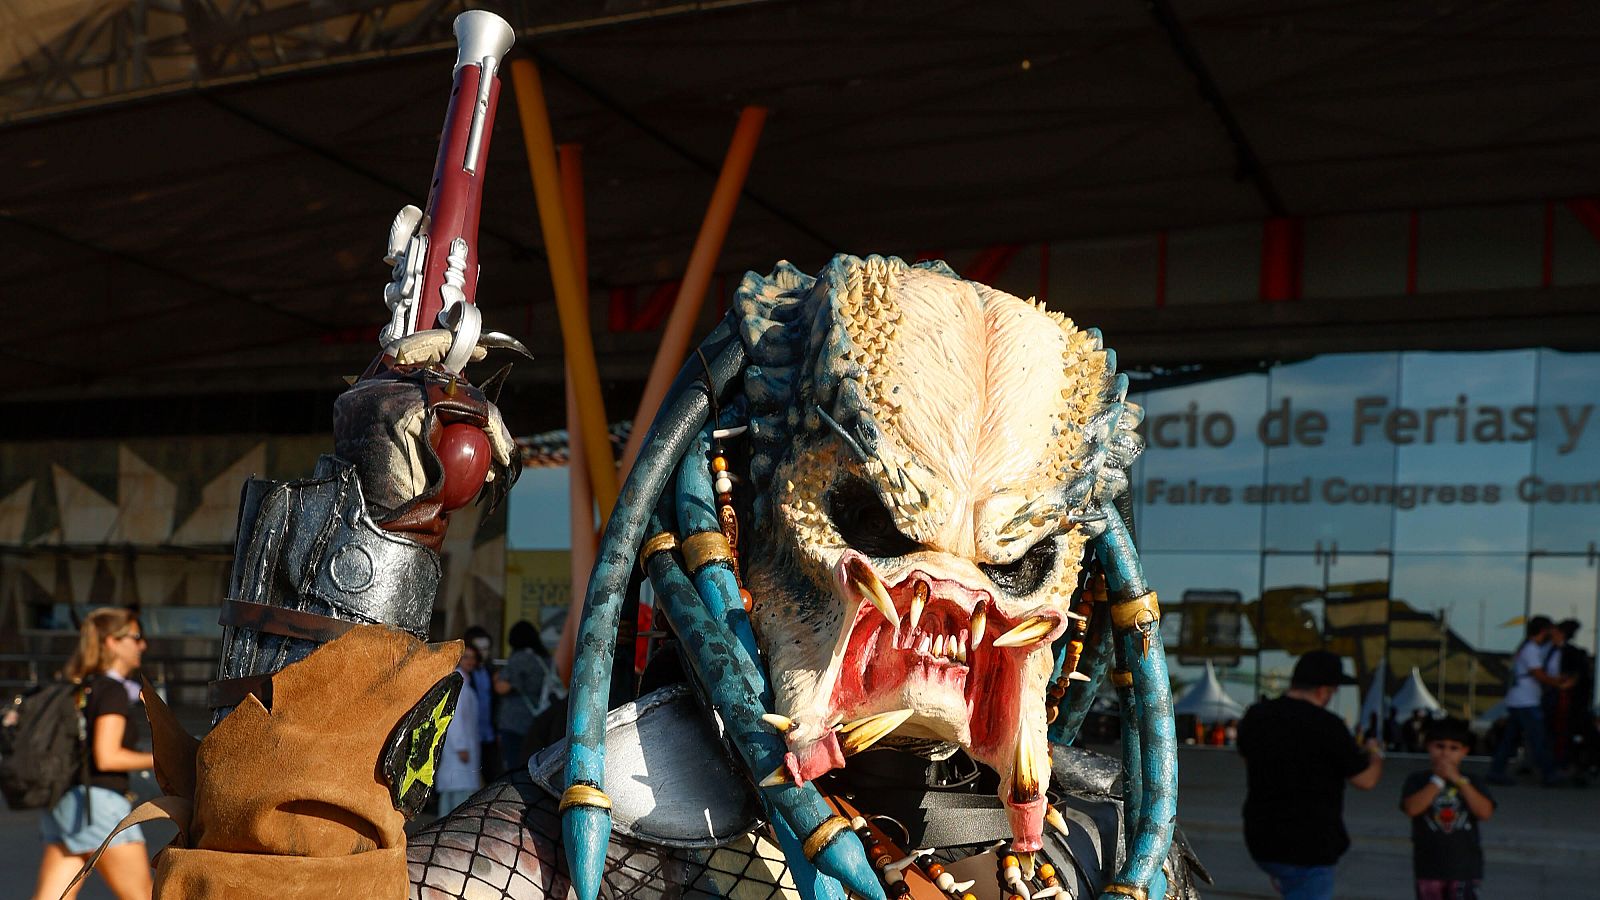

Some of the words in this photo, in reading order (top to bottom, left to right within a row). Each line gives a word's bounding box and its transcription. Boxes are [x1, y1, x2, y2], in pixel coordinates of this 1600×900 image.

[1258, 397, 1328, 446] de
[1353, 394, 1537, 445] Ferias
[1556, 404, 1595, 455] y
[1146, 478, 1232, 505] Fairs
[1244, 478, 1313, 504] and
[1321, 478, 1502, 510] Congress
